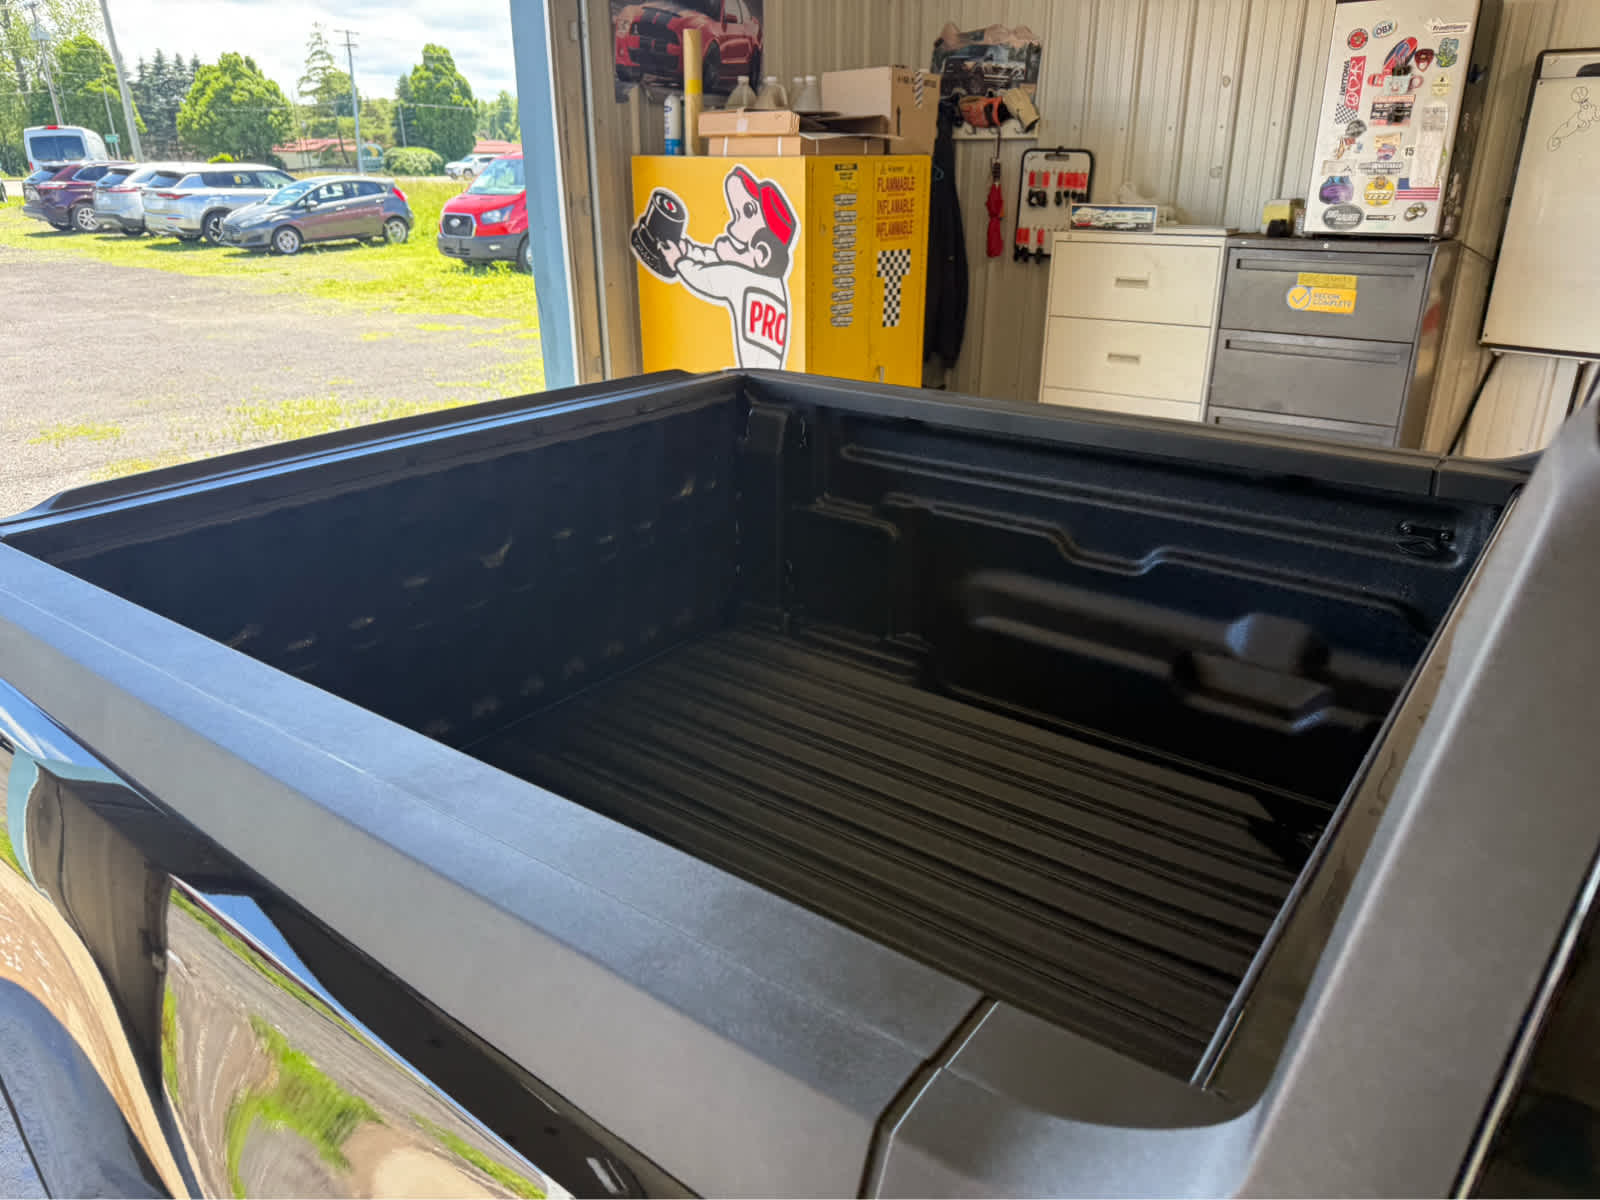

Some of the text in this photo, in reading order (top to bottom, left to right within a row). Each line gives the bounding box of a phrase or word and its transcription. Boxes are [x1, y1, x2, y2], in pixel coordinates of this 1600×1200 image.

[1375, 23, 1393, 35] OBX
[1404, 147, 1414, 156] 15
[877, 175, 915, 192] FLAMMABLE
